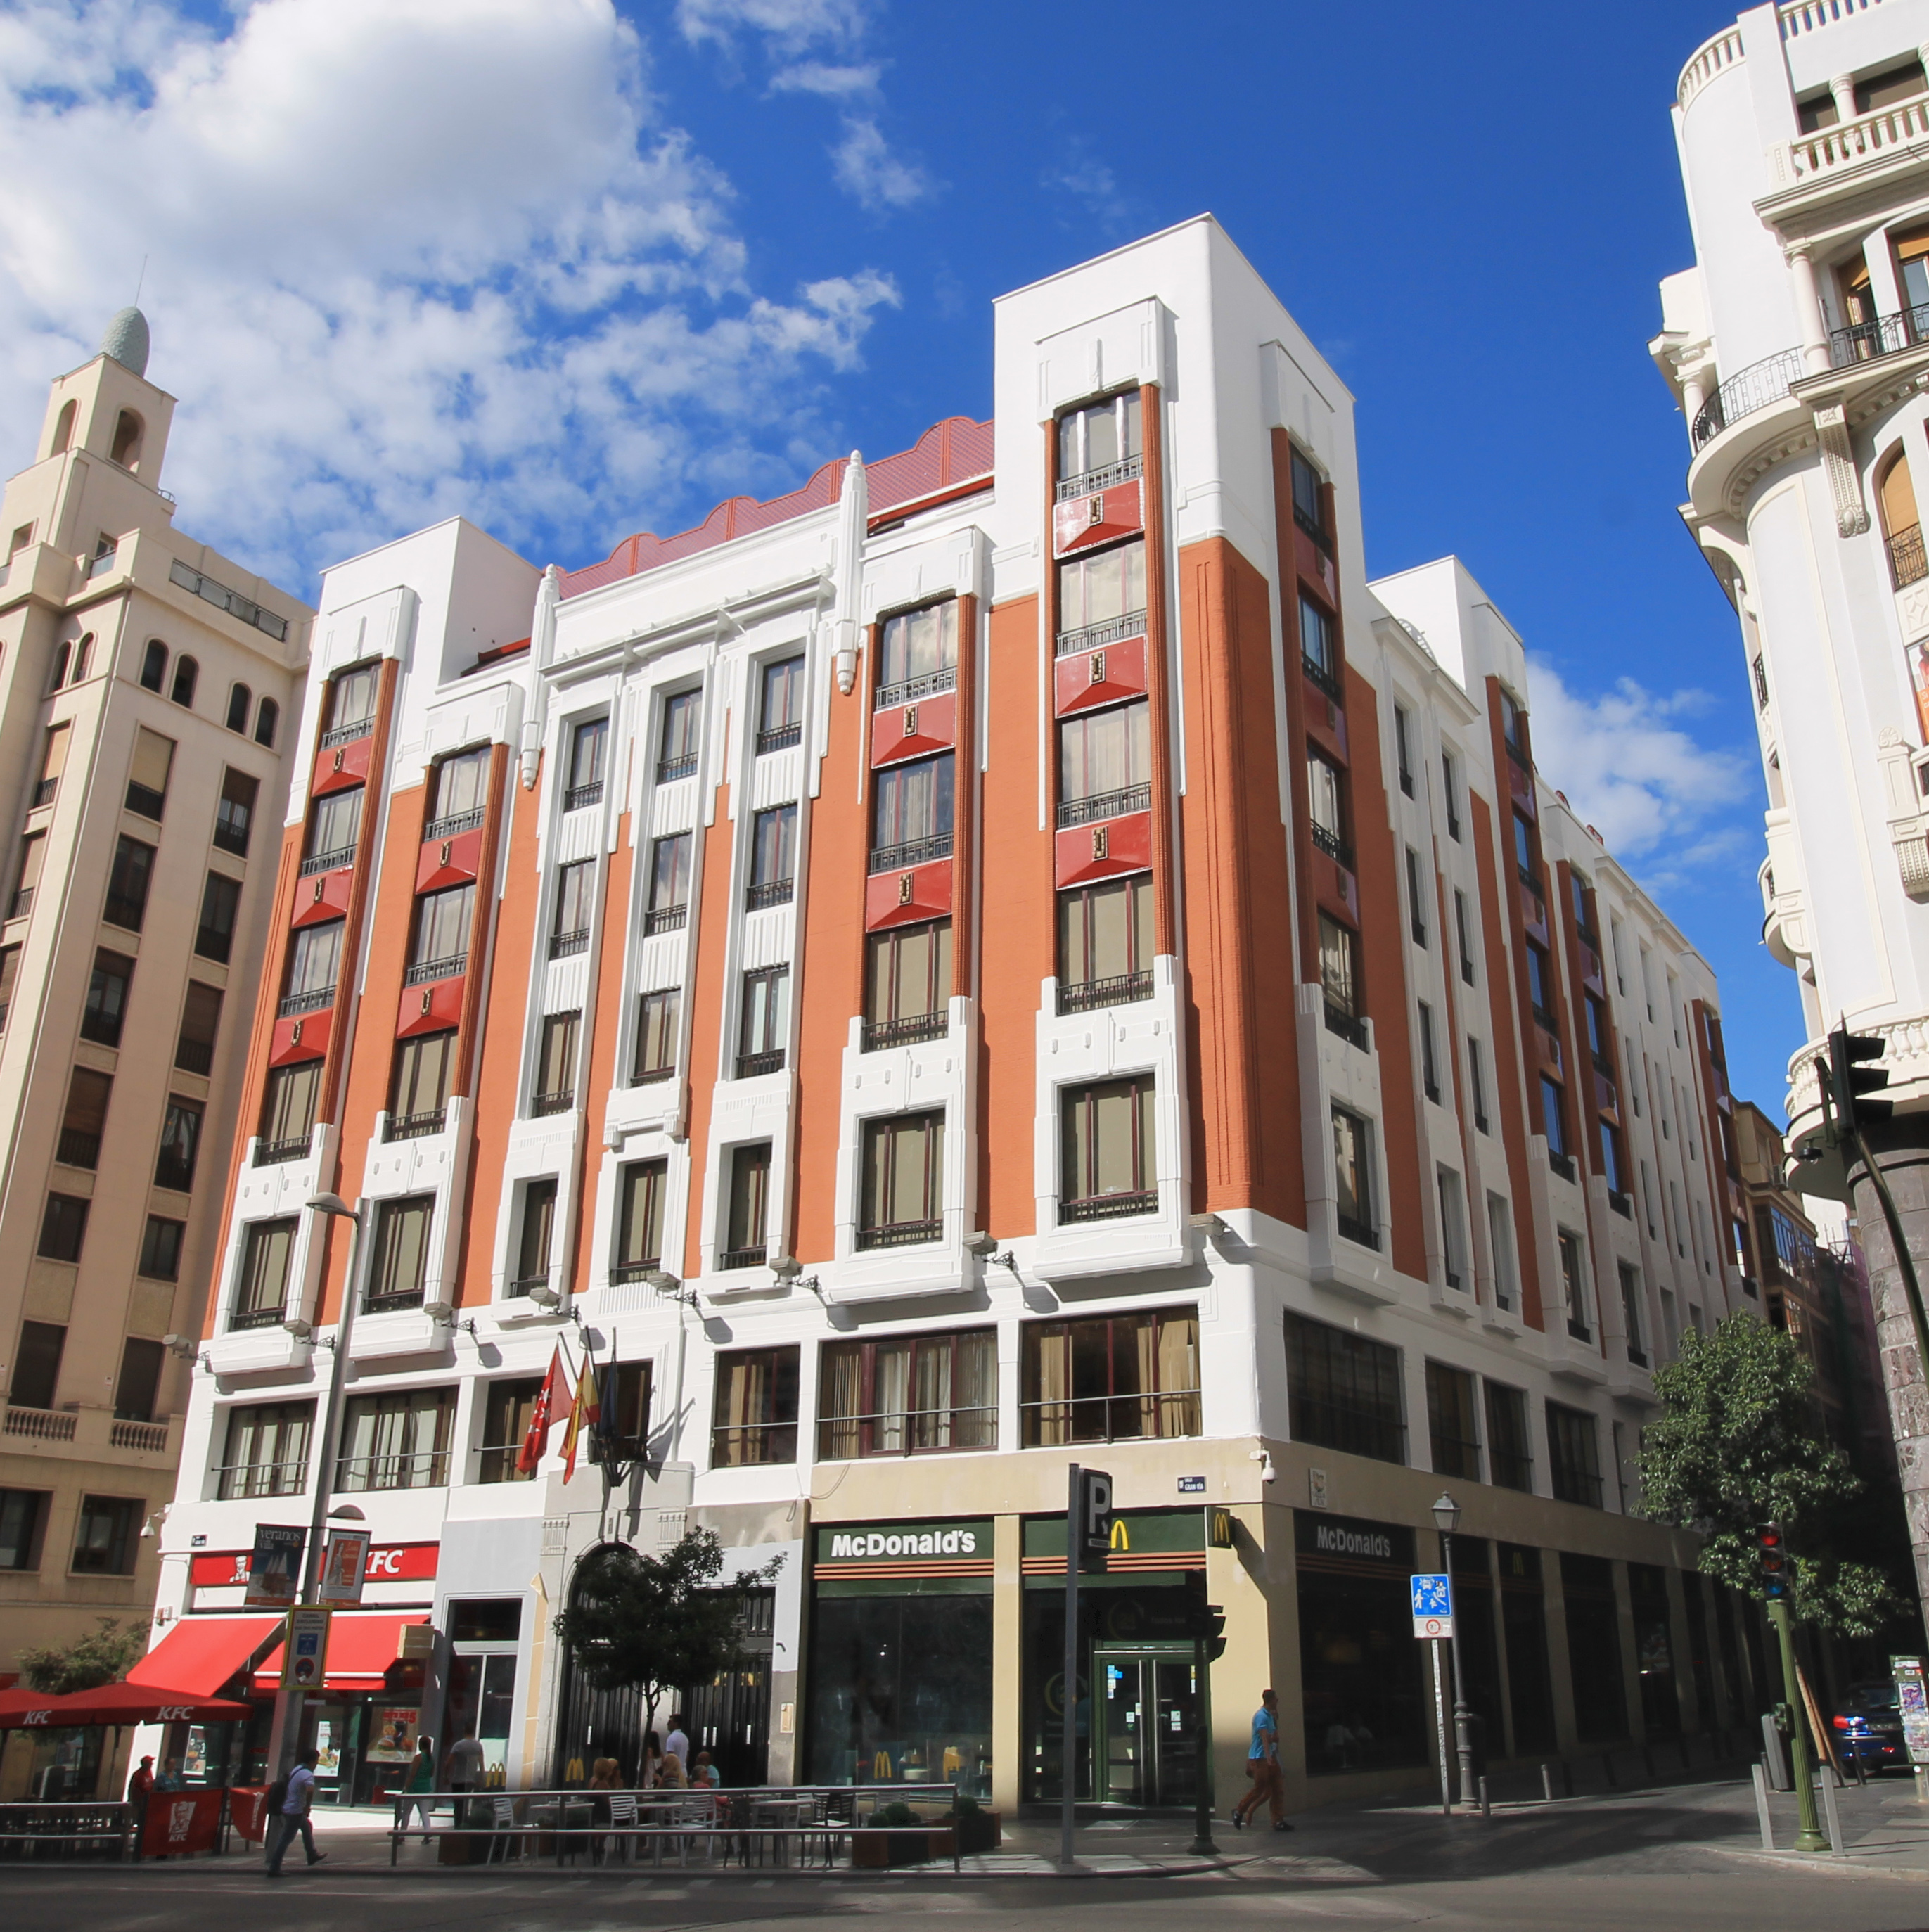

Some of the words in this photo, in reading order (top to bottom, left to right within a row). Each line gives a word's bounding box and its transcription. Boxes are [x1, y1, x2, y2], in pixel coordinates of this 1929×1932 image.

[1089, 1476, 1111, 1534] P
[260, 1529, 301, 1542] veranos
[1317, 1525, 1391, 1557] McDonald's
[831, 1530, 976, 1557] McDonald's
[23, 1710, 53, 1725] KFC
[156, 1706, 194, 1720] KFC
[168, 1834, 187, 1843] KFC
